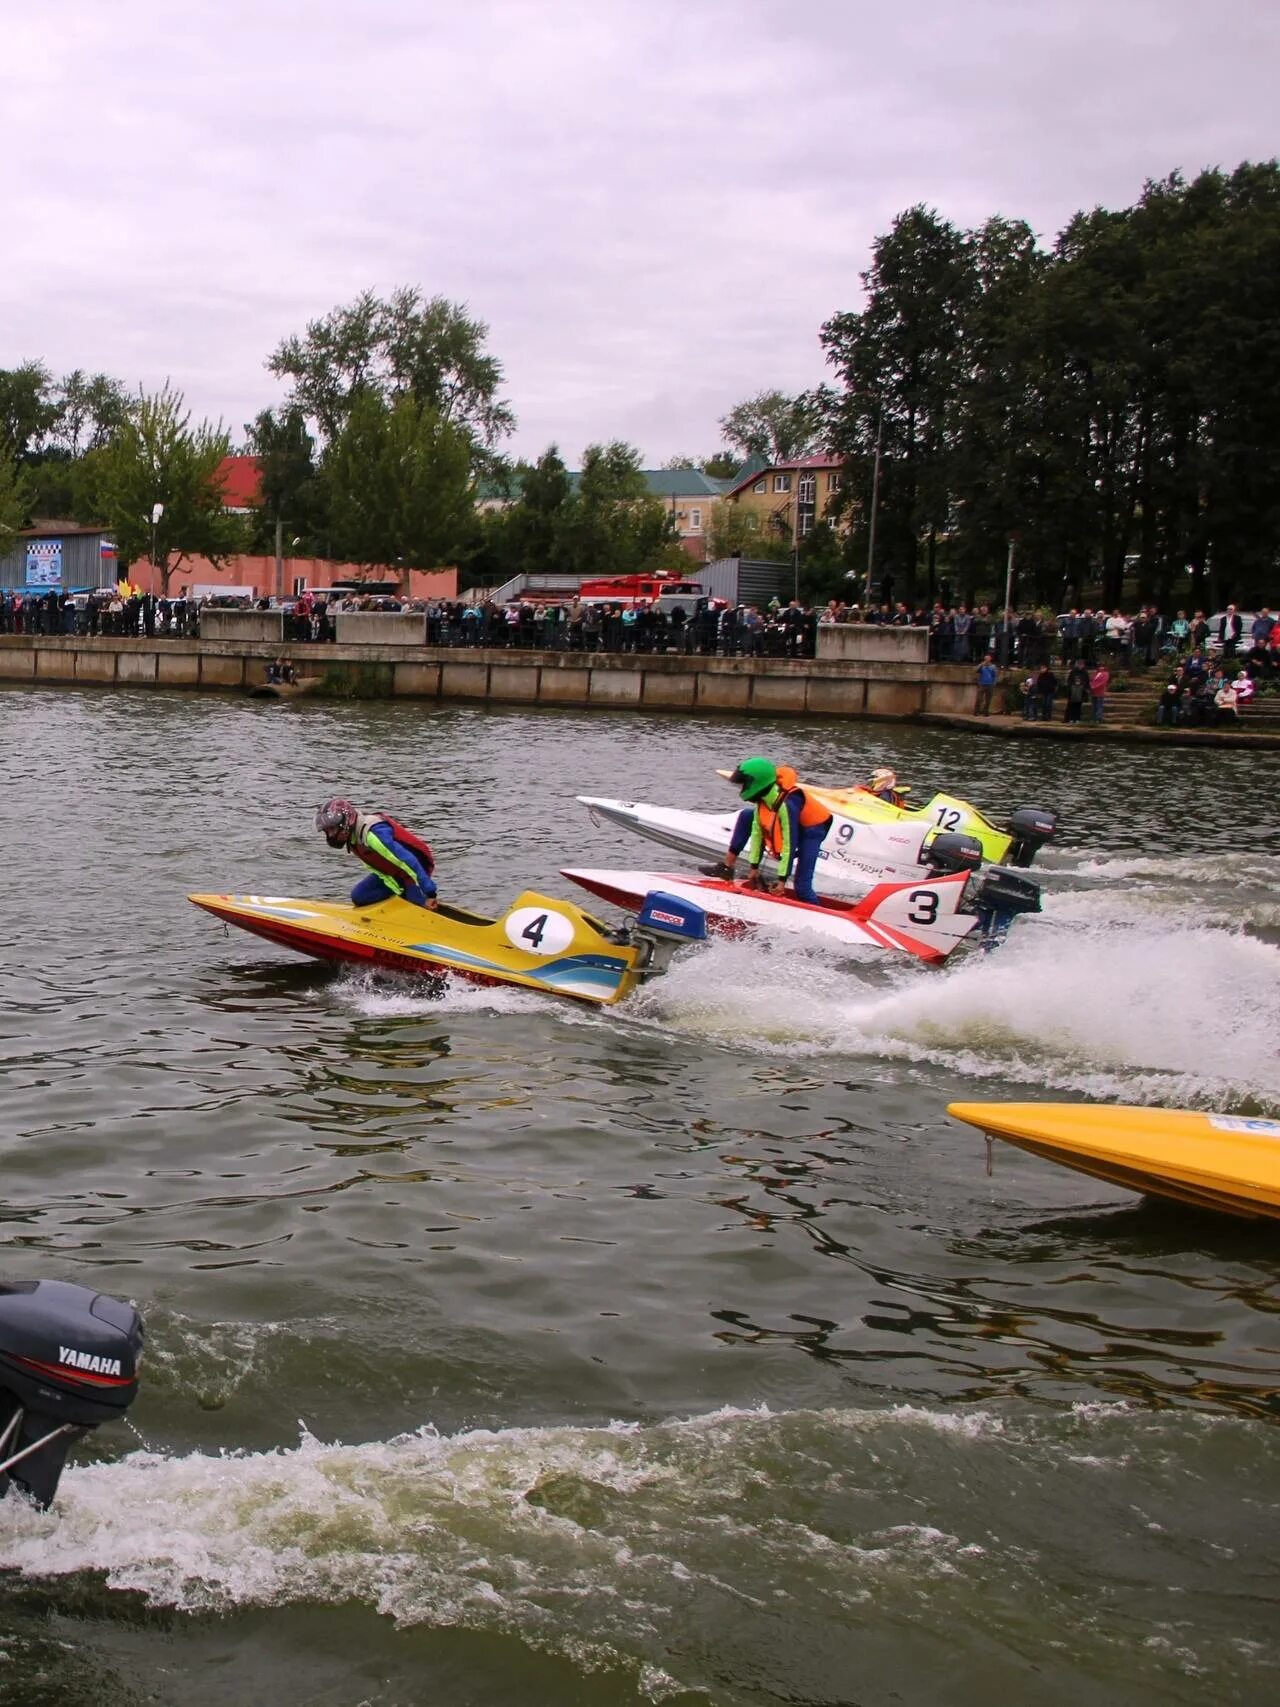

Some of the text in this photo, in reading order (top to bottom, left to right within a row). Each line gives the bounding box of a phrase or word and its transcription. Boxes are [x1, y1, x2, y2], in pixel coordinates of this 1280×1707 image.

[836, 824, 854, 845] 9
[937, 808, 961, 832] 12
[908, 890, 939, 925] 3
[522, 914, 548, 948] 4
[59, 1346, 121, 1376] YAMAHA
